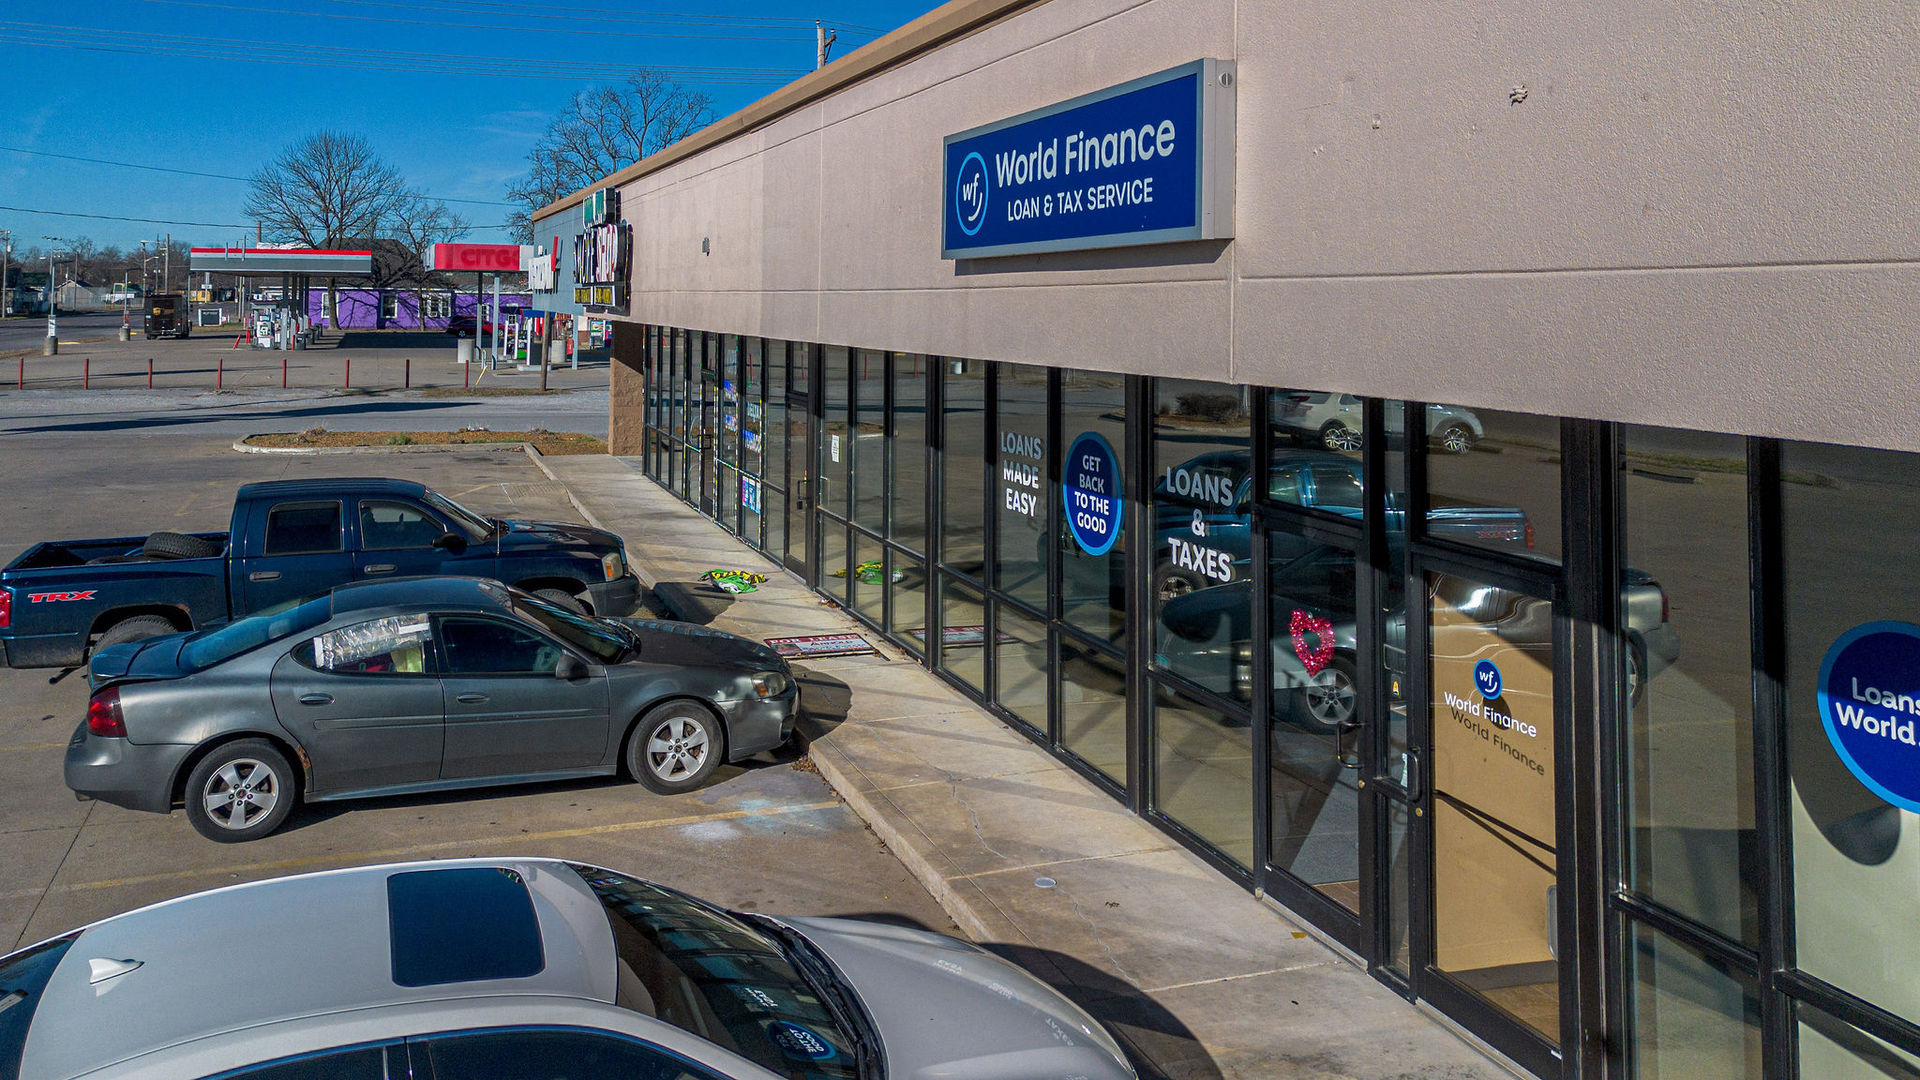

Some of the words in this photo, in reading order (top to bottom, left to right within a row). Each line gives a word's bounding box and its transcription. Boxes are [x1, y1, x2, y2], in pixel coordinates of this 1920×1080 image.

[996, 138, 1058, 188] World
[1065, 120, 1176, 175] Finance
[1008, 196, 1040, 222] LOAN
[1044, 195, 1053, 216] &
[1057, 189, 1083, 215] TAX
[1087, 178, 1153, 210] SERVICE
[1000, 432, 1042, 460] LOANS
[1004, 460, 1039, 490] MADE
[1082, 454, 1101, 472] GET
[1079, 474, 1104, 494] BACK
[1166, 466, 1233, 508] LOANS
[1006, 488, 1036, 517] EASY
[1074, 491, 1088, 509] TO
[1088, 496, 1110, 516] THE
[1077, 511, 1106, 534] GOOD
[1191, 509, 1205, 538] &
[1167, 537, 1232, 582] TAXES
[28, 590, 98, 603] TRX
[1444, 692, 1480, 717] World
[1484, 706, 1537, 738] Finance
[1450, 708, 1490, 741] World
[1493, 734, 1545, 776] Finance
